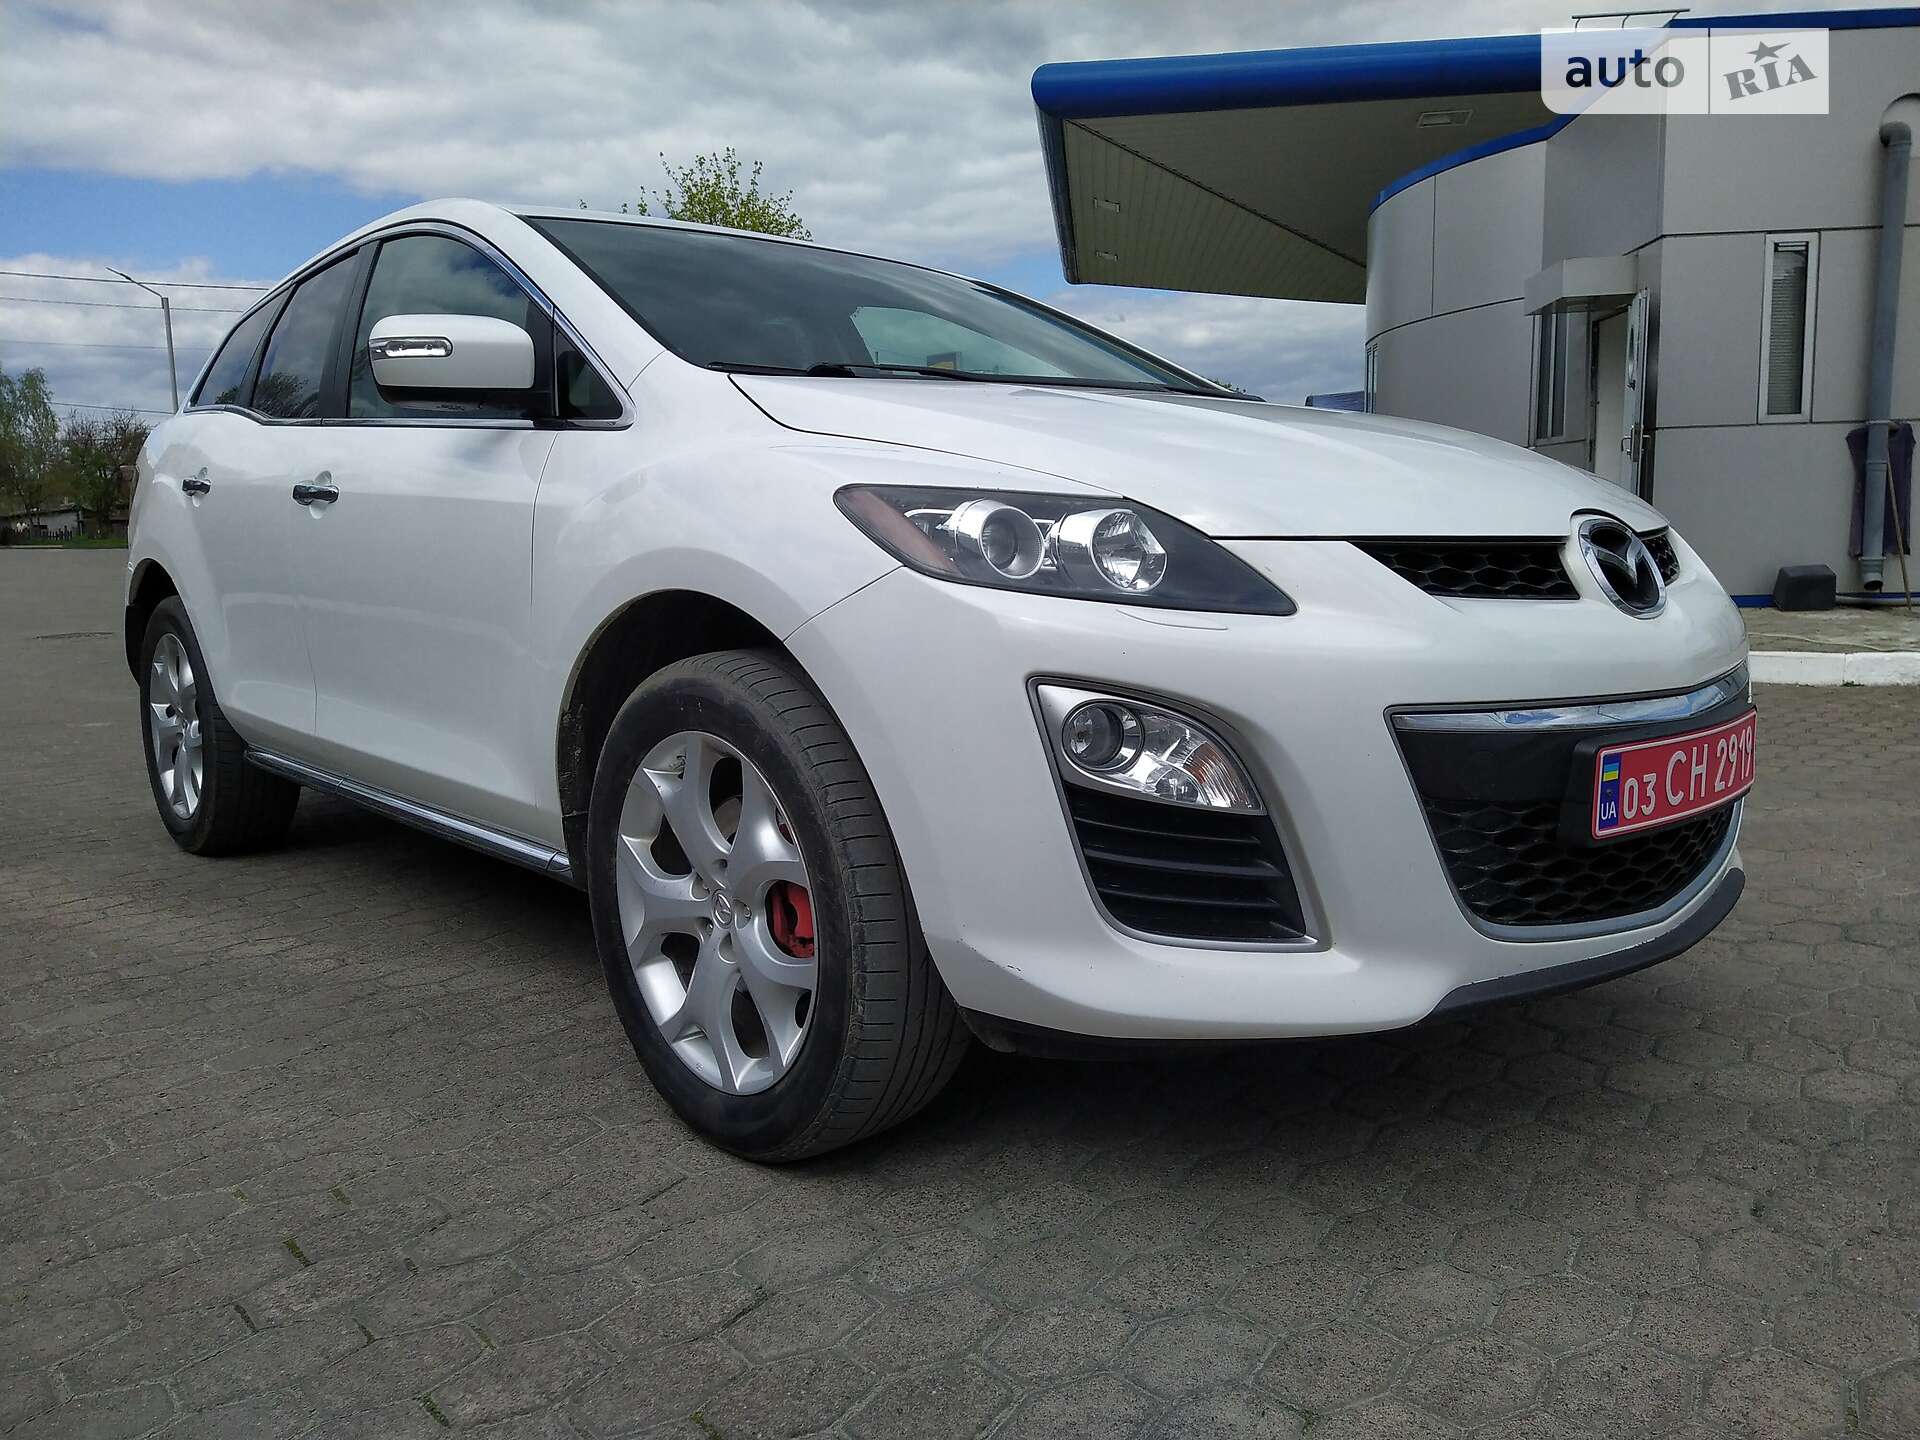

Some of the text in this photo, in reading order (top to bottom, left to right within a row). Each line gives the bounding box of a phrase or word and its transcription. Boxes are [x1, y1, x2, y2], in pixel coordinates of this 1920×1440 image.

[1623, 725, 1753, 820] 03 CH 2919
[1600, 801, 1617, 821] UA
